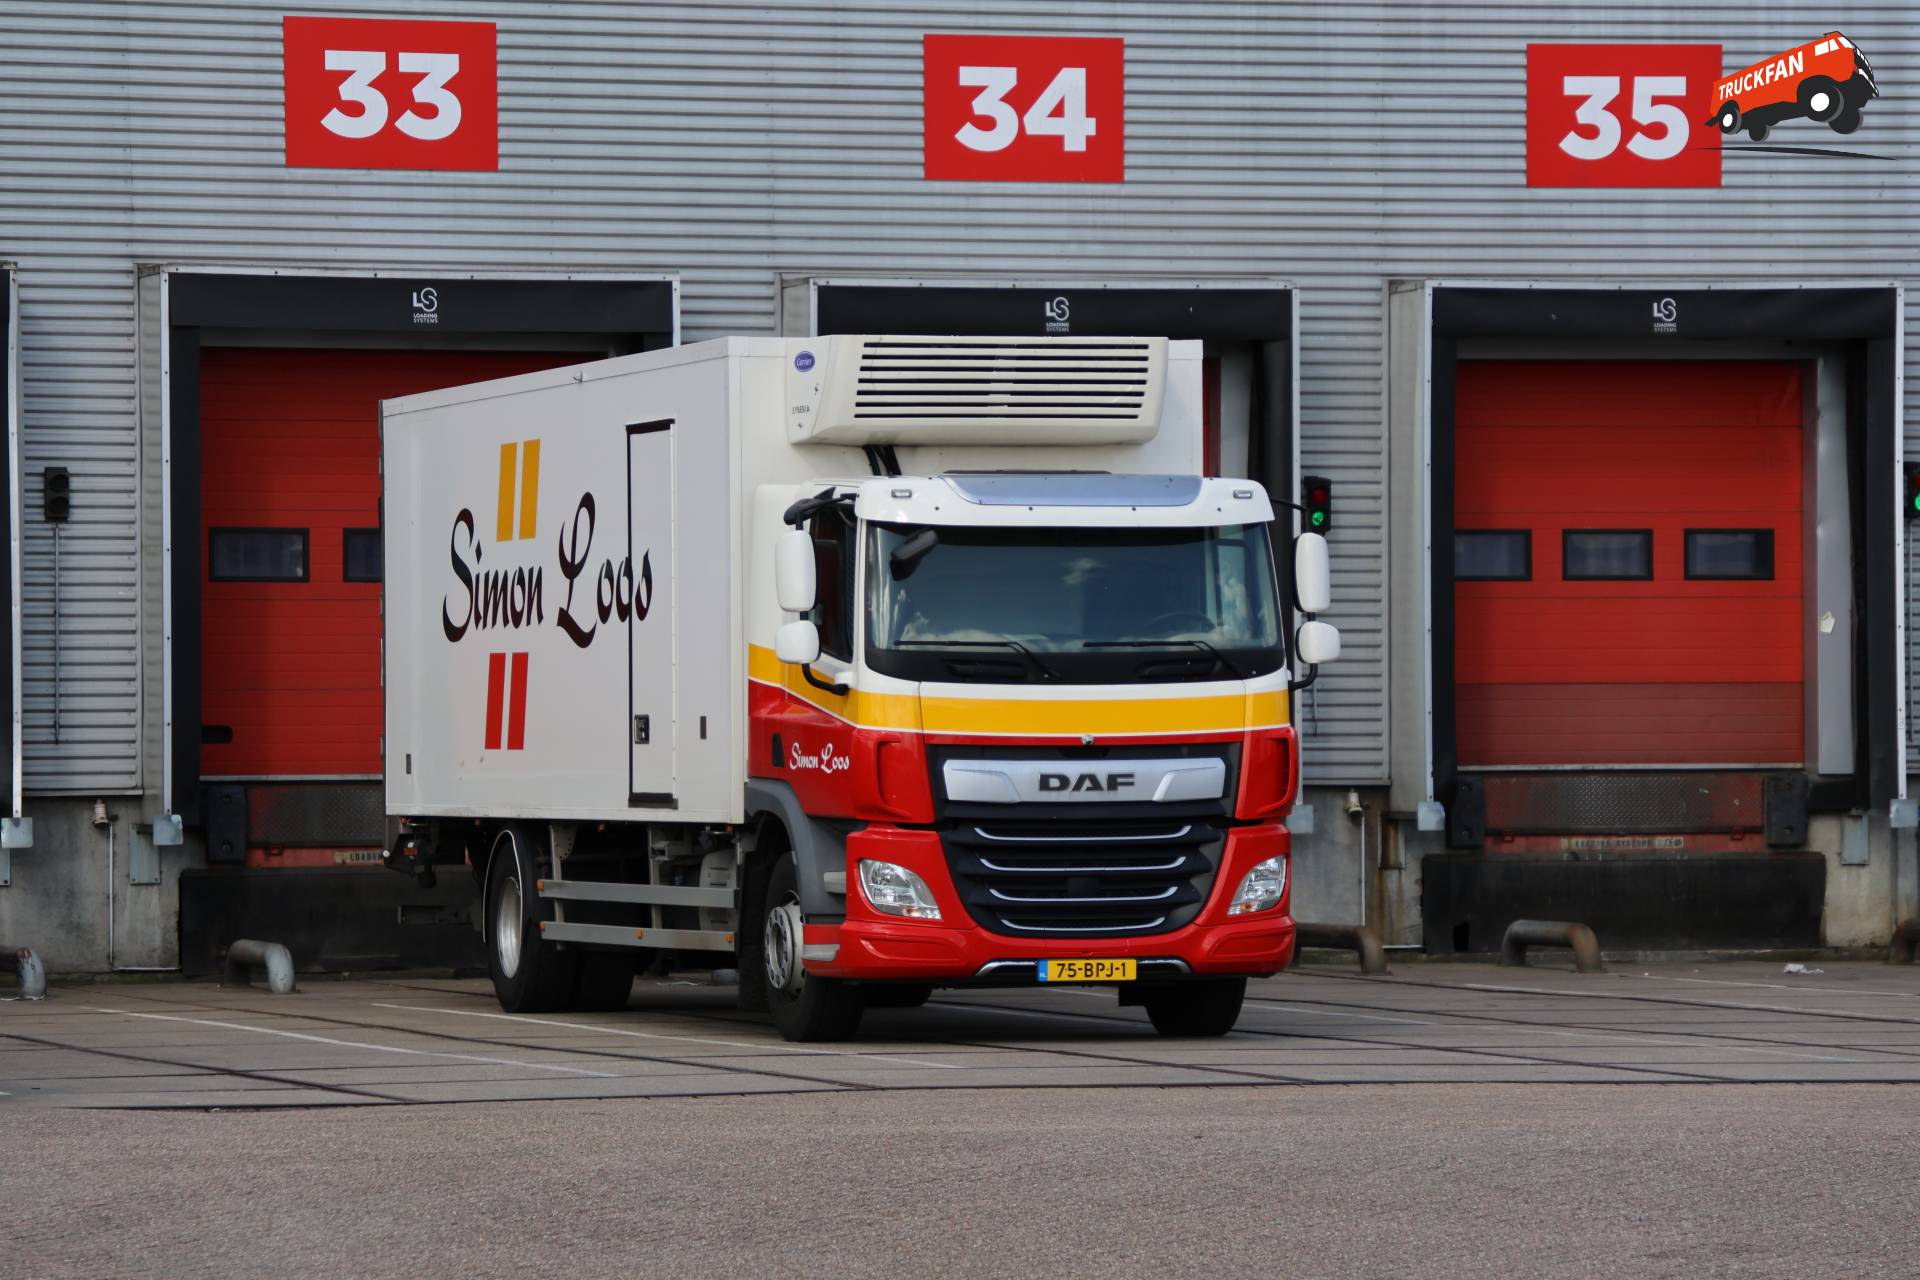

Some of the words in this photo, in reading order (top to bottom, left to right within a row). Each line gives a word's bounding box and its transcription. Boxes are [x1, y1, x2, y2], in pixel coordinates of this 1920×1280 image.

[321, 50, 462, 141] 33
[954, 66, 1097, 152] 34
[1558, 76, 1690, 160] 35
[413, 287, 438, 312] LS
[1045, 296, 1070, 321] LS
[1653, 297, 1677, 321] LS
[442, 507, 544, 643] Simon
[556, 491, 653, 649] Loos
[789, 742, 819, 770] Simon
[820, 743, 850, 774] Loos
[1039, 773, 1136, 792] DAF
[1056, 962, 1126, 978] 75-BPJ-1
